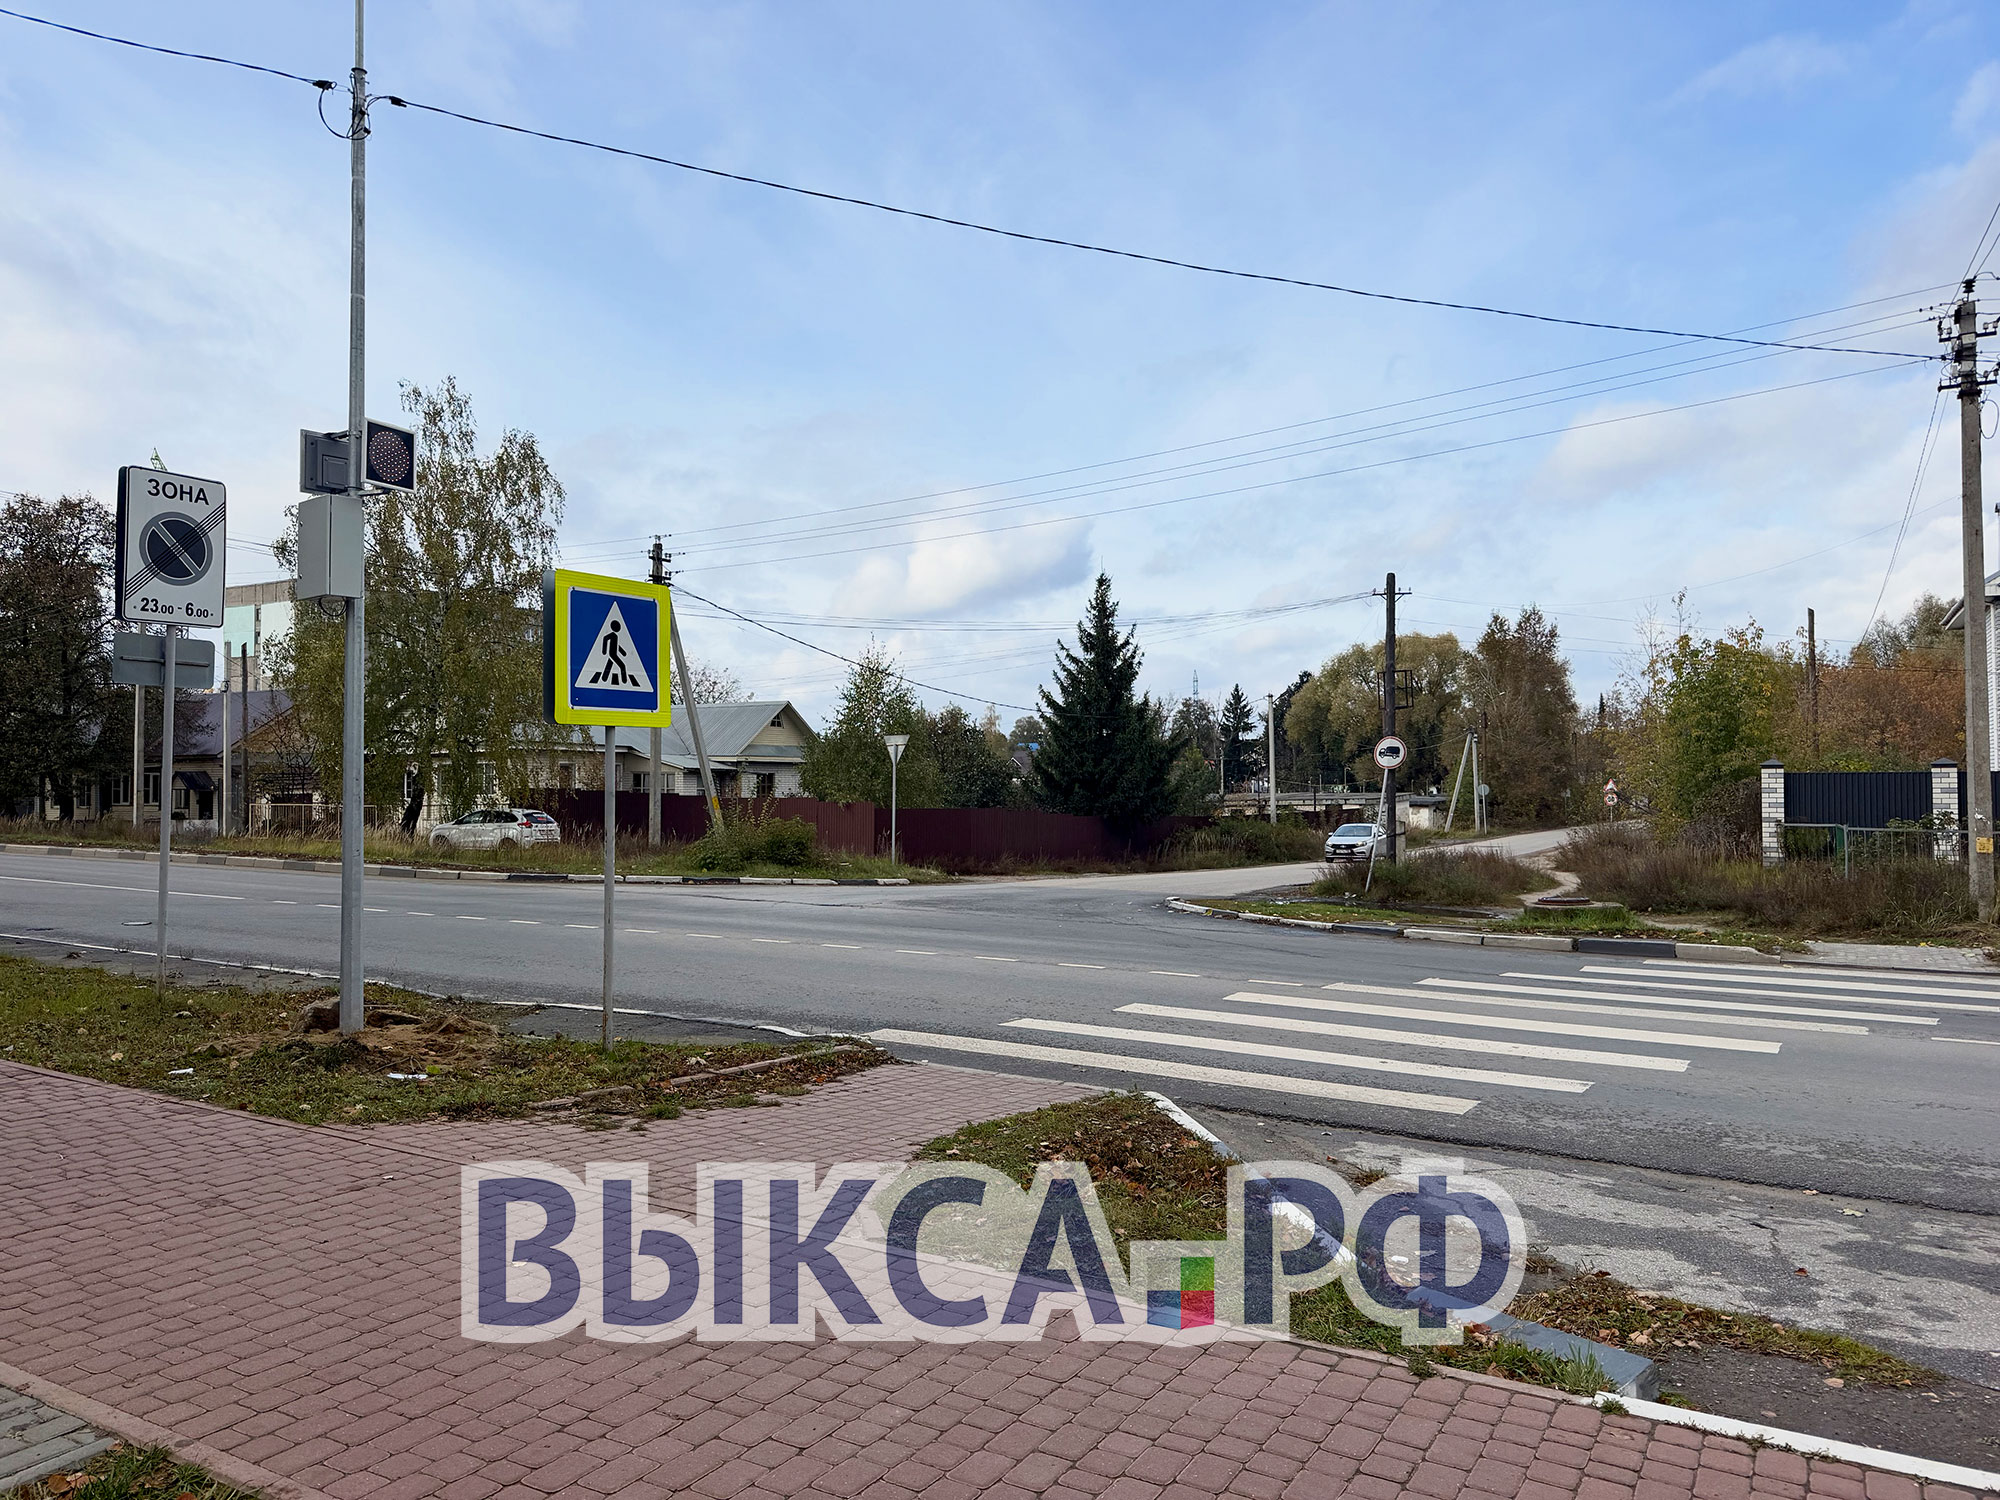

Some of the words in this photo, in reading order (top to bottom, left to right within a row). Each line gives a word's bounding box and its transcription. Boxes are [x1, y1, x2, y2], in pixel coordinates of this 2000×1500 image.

[147, 478, 210, 506] ЗОНА
[140, 597, 175, 615] 23.00
[185, 602, 209, 618] 6.00
